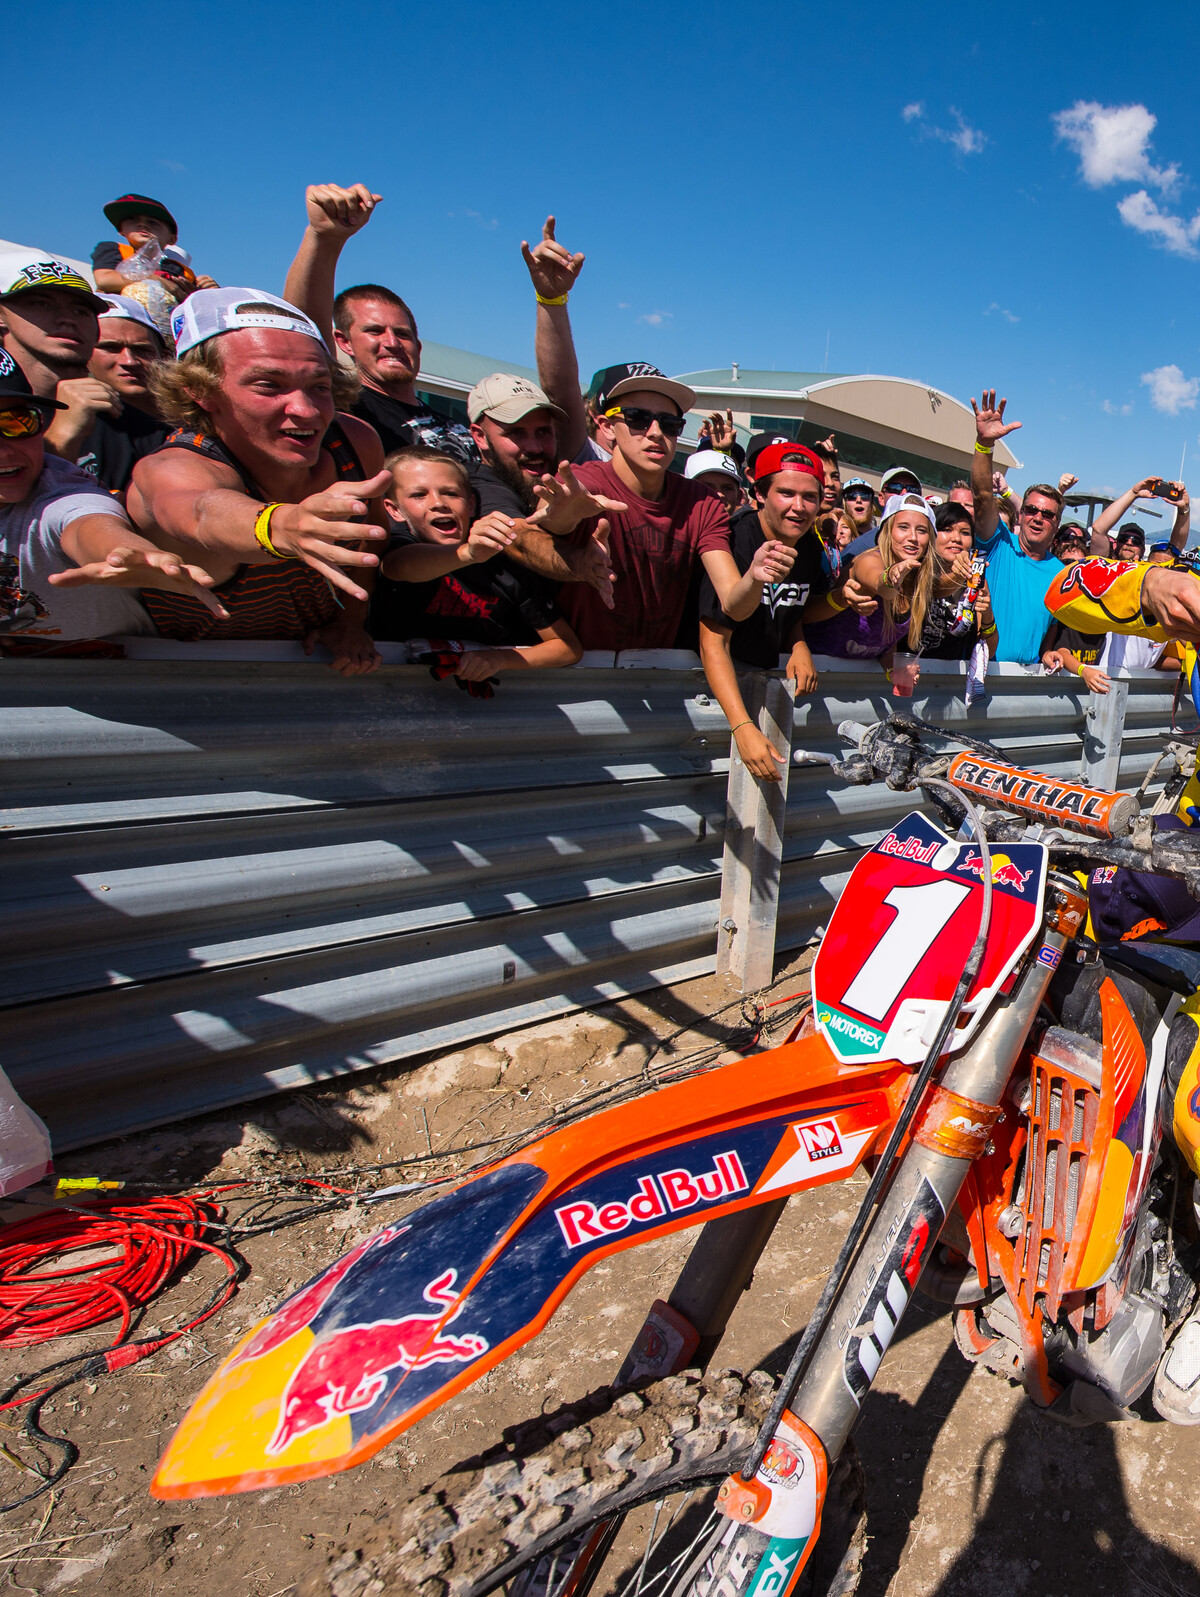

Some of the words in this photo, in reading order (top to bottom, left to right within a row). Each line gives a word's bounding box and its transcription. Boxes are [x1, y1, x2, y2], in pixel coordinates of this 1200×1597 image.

[971, 562, 986, 576] 94
[953, 761, 1103, 820] RENTHAL
[878, 833, 911, 855] Red
[906, 836, 940, 864] Bull
[839, 878, 975, 1023] 1
[828, 1013, 883, 1050] MOTOREX
[810, 1145, 841, 1160] STYLE
[554, 1174, 667, 1249] Red
[657, 1150, 750, 1213] Bull
